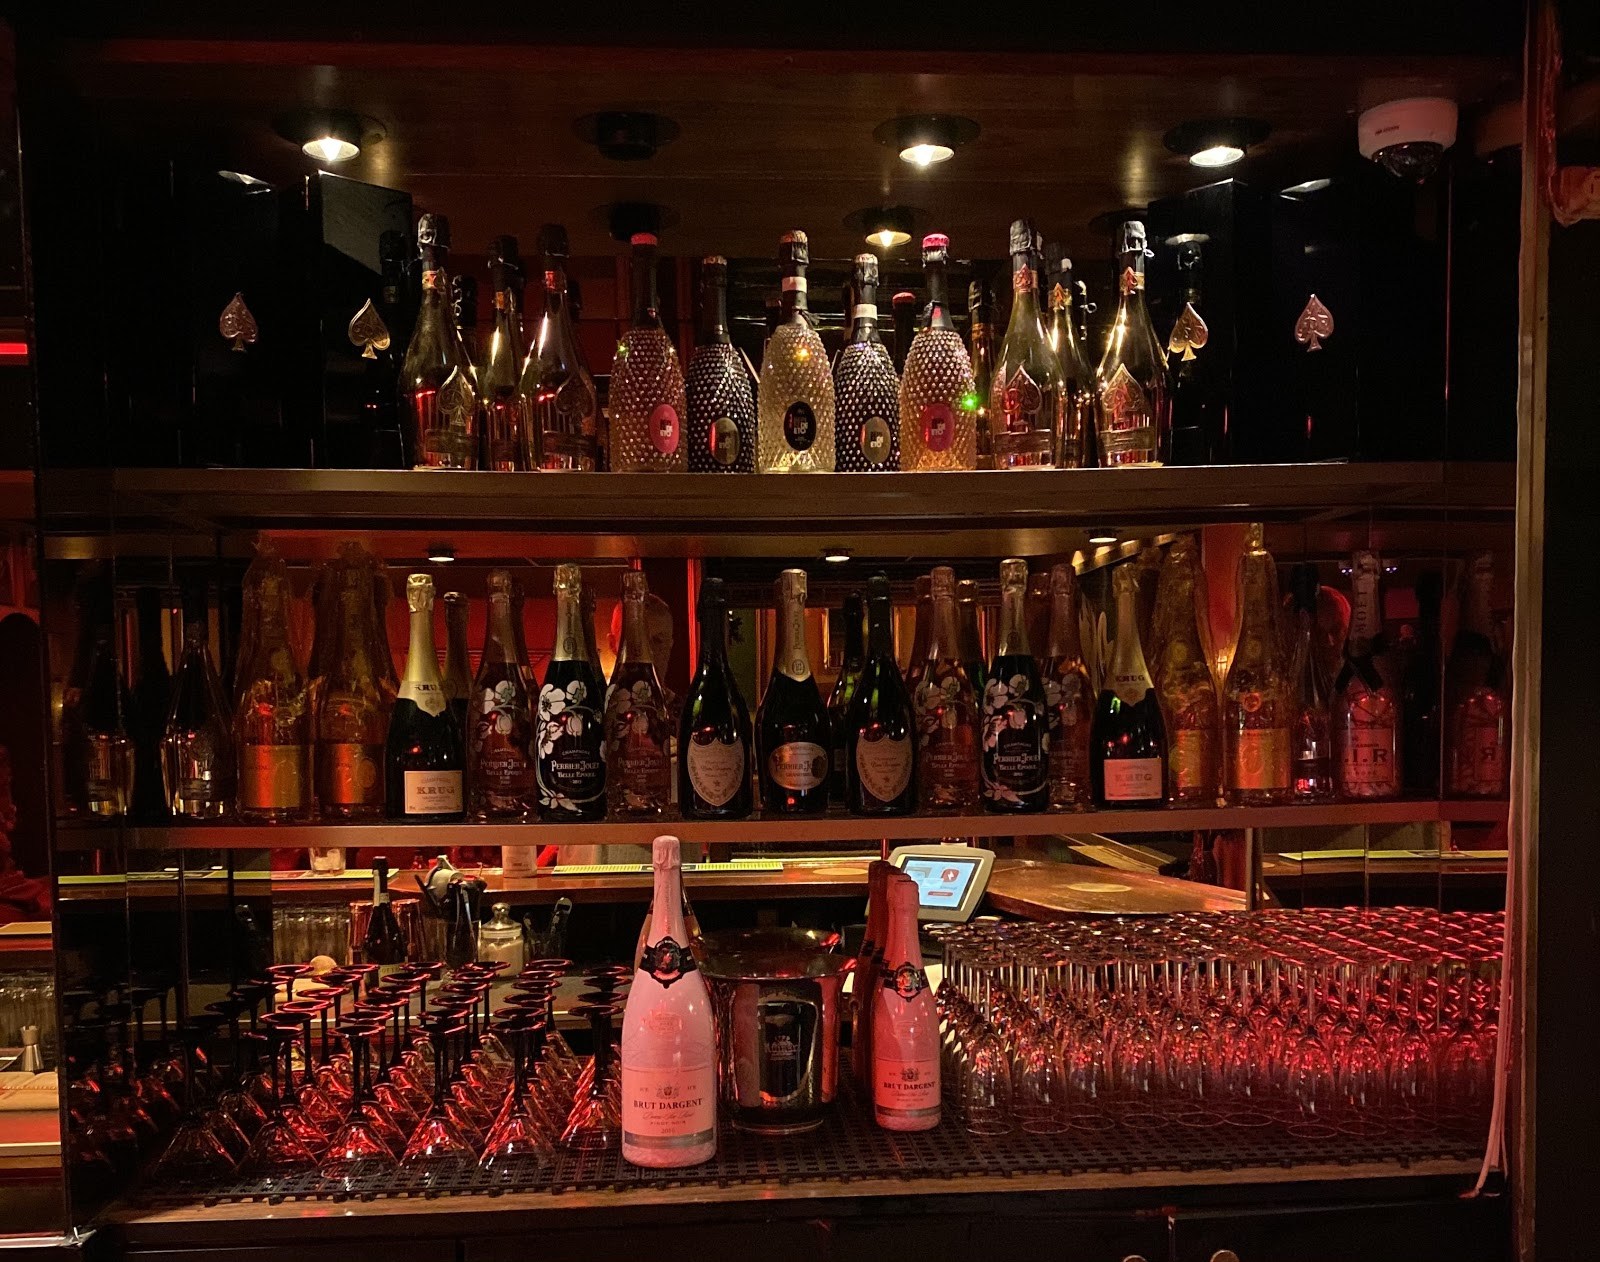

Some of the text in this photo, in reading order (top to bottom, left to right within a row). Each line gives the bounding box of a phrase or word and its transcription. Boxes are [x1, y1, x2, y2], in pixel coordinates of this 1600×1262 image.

[416, 786, 455, 795] KRUG
[903, 1081, 936, 1090] DARGENT
[633, 1098, 703, 1109] BRUT DARGENT
